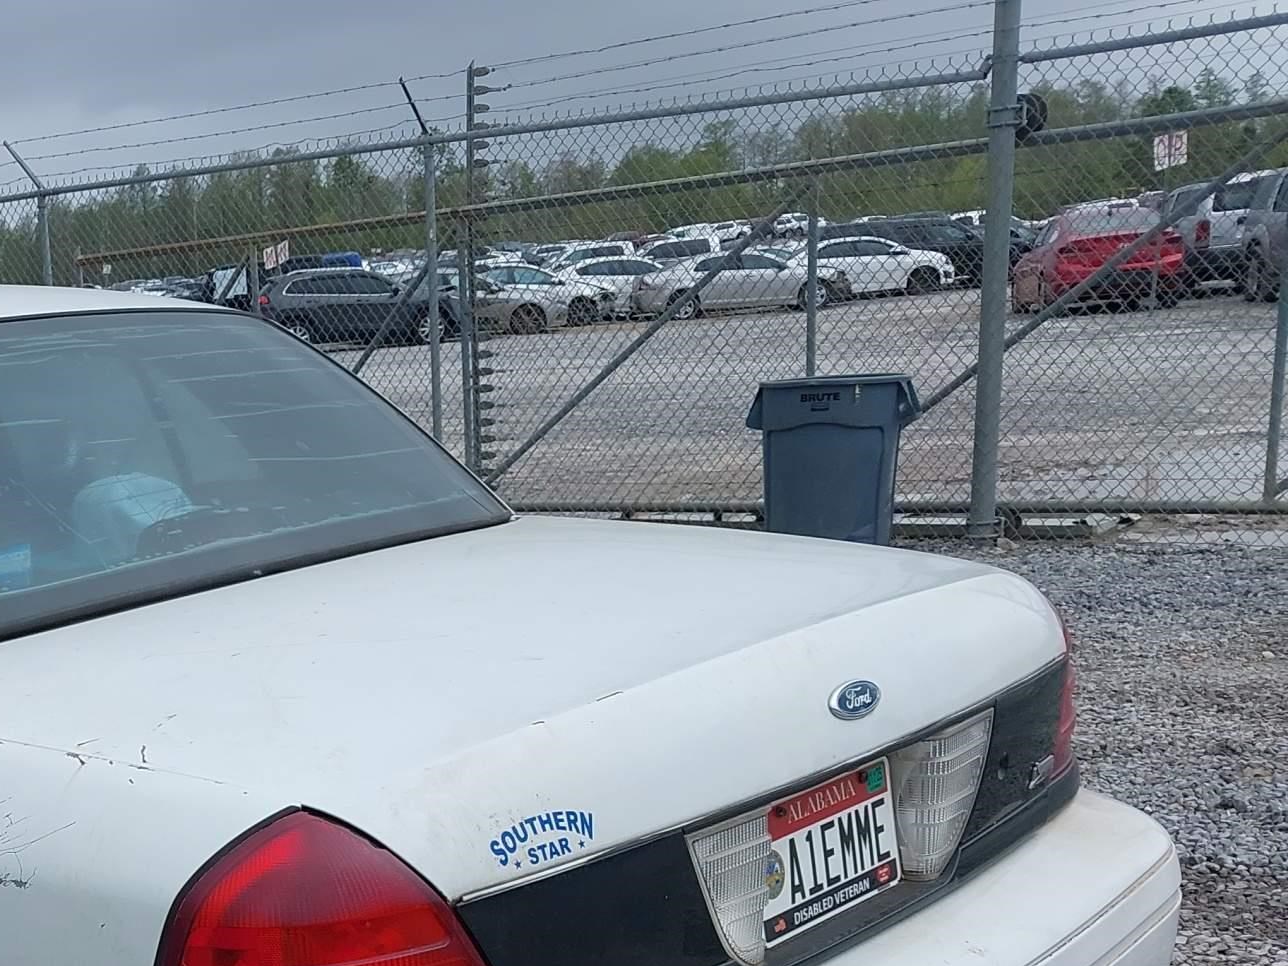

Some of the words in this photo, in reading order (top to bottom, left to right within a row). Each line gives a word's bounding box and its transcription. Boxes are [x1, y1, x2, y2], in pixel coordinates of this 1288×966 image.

[800, 392, 841, 403] BRUTE
[845, 686, 872, 709] Ford
[787, 779, 857, 825] ALABAMA
[489, 811, 594, 867] SOUTHERN
[527, 837, 572, 865] STAR
[789, 797, 891, 905] A1EMME
[794, 894, 833, 926] DISABLED
[834, 877, 871, 906] VETERAN
